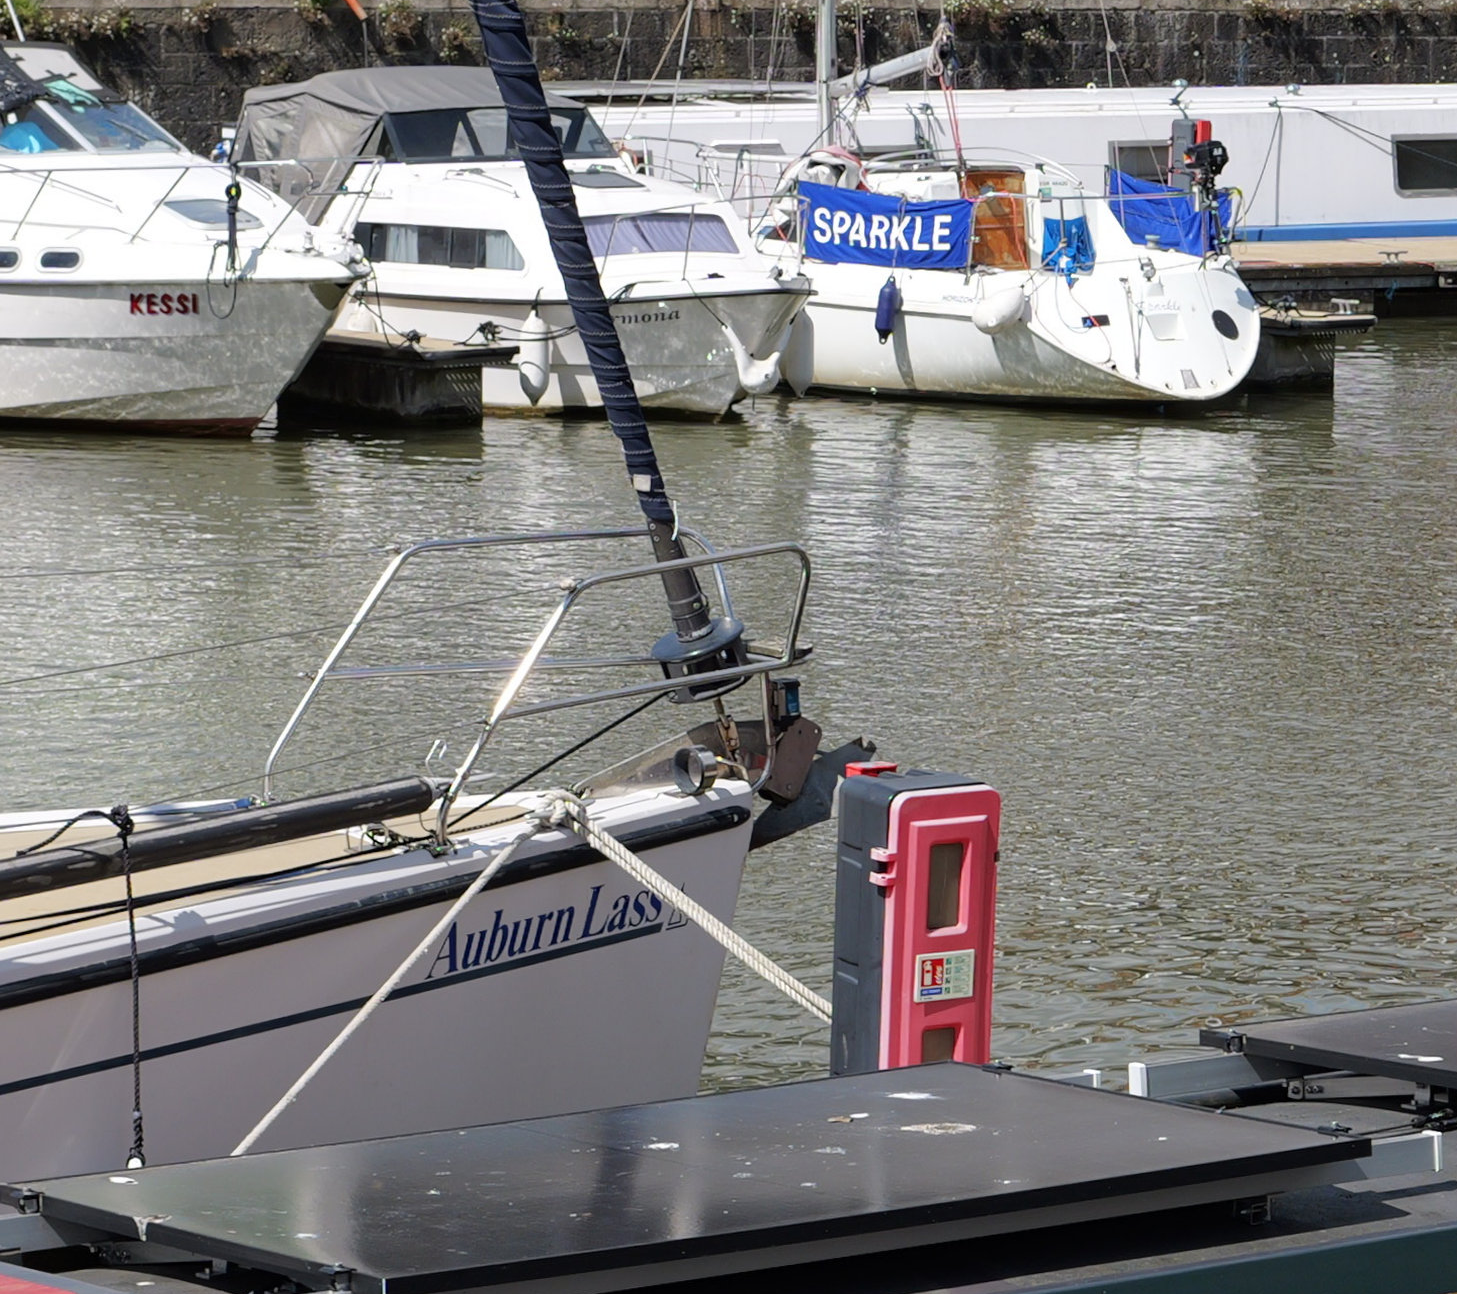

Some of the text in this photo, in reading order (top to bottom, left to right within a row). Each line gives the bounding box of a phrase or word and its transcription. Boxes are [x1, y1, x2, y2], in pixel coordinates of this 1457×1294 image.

[813, 207, 952, 251] SPARKLE
[129, 293, 200, 315] KESSI
[423, 883, 663, 981] Auburn Lass
